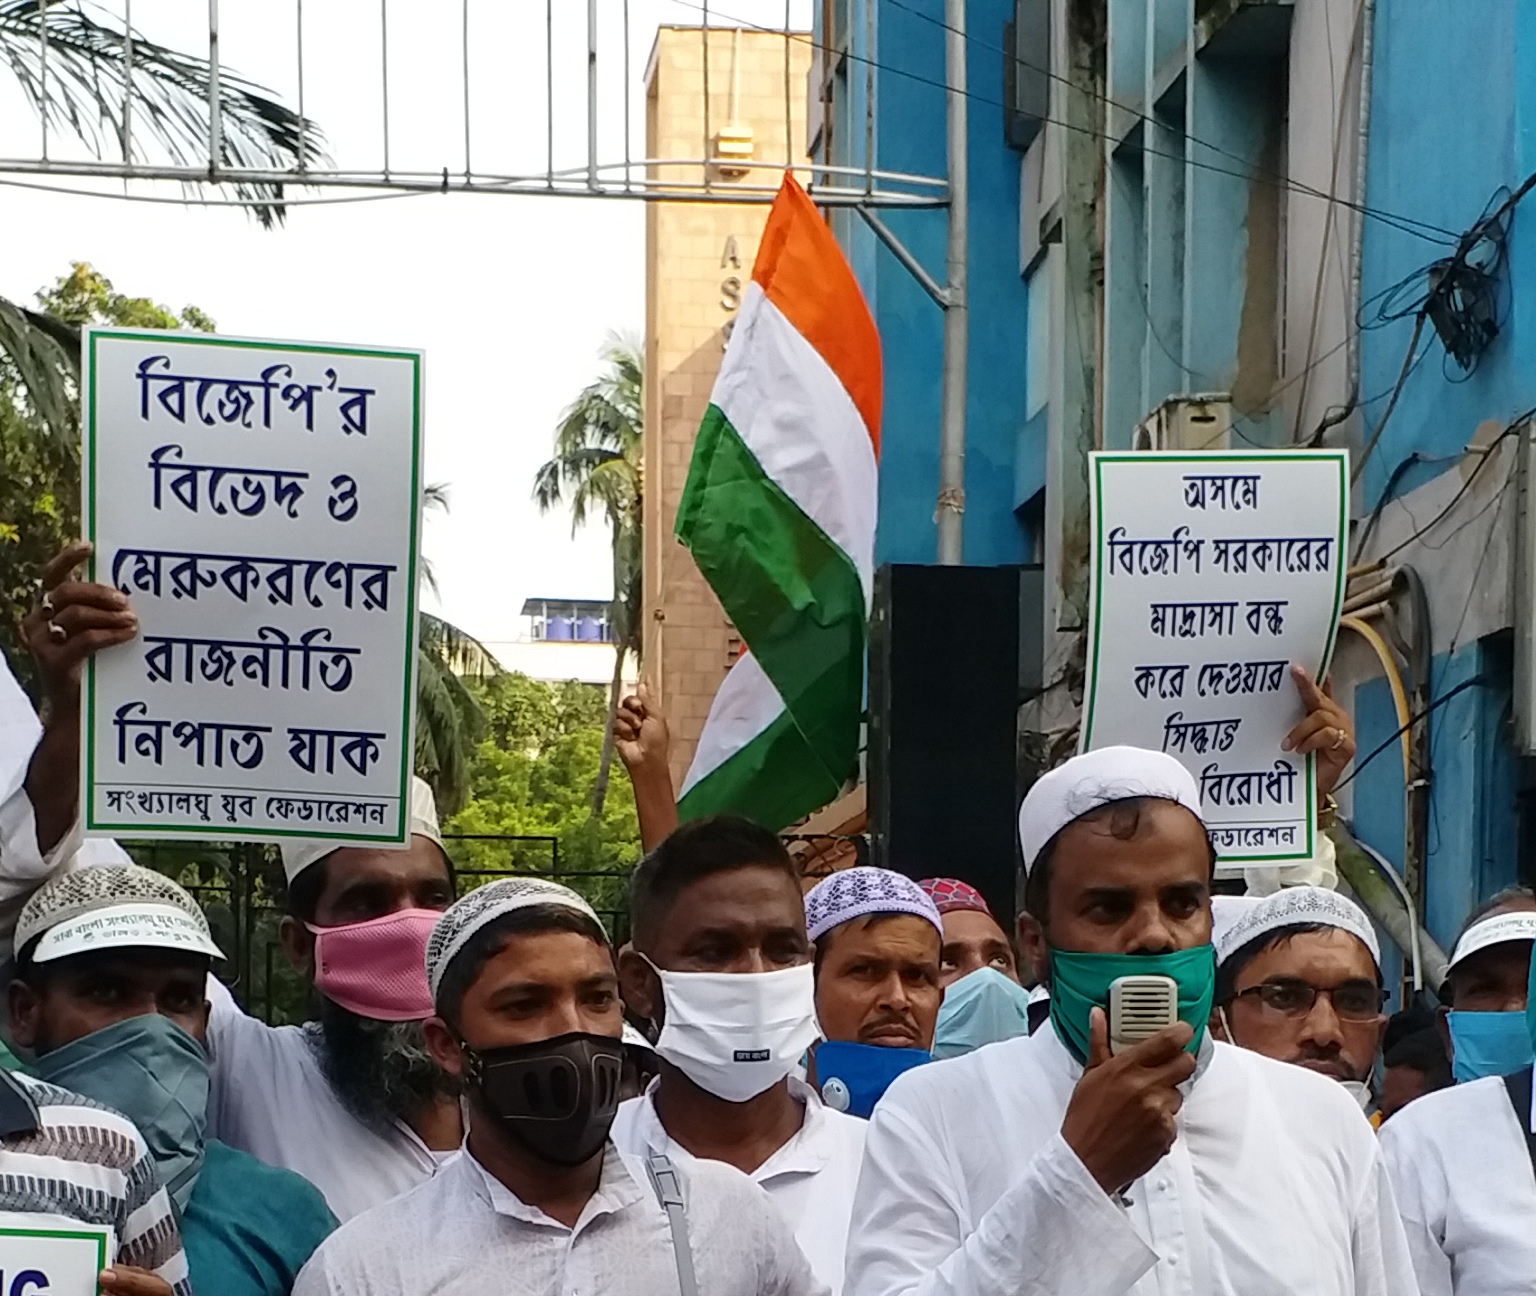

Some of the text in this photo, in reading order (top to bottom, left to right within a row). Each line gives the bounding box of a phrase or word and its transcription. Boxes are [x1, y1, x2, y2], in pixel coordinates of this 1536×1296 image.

[149, 444, 359, 522] বিভেদ ও
[1183, 475, 1261, 510] অসমে
[1107, 527, 1334, 576] বিজেপি সরকারের
[112, 548, 397, 612] মেরুকরণের
[1150, 601, 1289, 638] মাদ্রাসা বন্ধ
[144, 627, 361, 692] রাজনীতি
[1134, 660, 1289, 699] করে দেওয়ার
[113, 701, 386, 776] নিপাত যাক
[1163, 712, 1241, 755] সিদ্ধান্ত
[1200, 760, 1297, 806] বিরোধী
[106, 789, 388, 826] সংখ্যালঘু যুব ফেডারেশন
